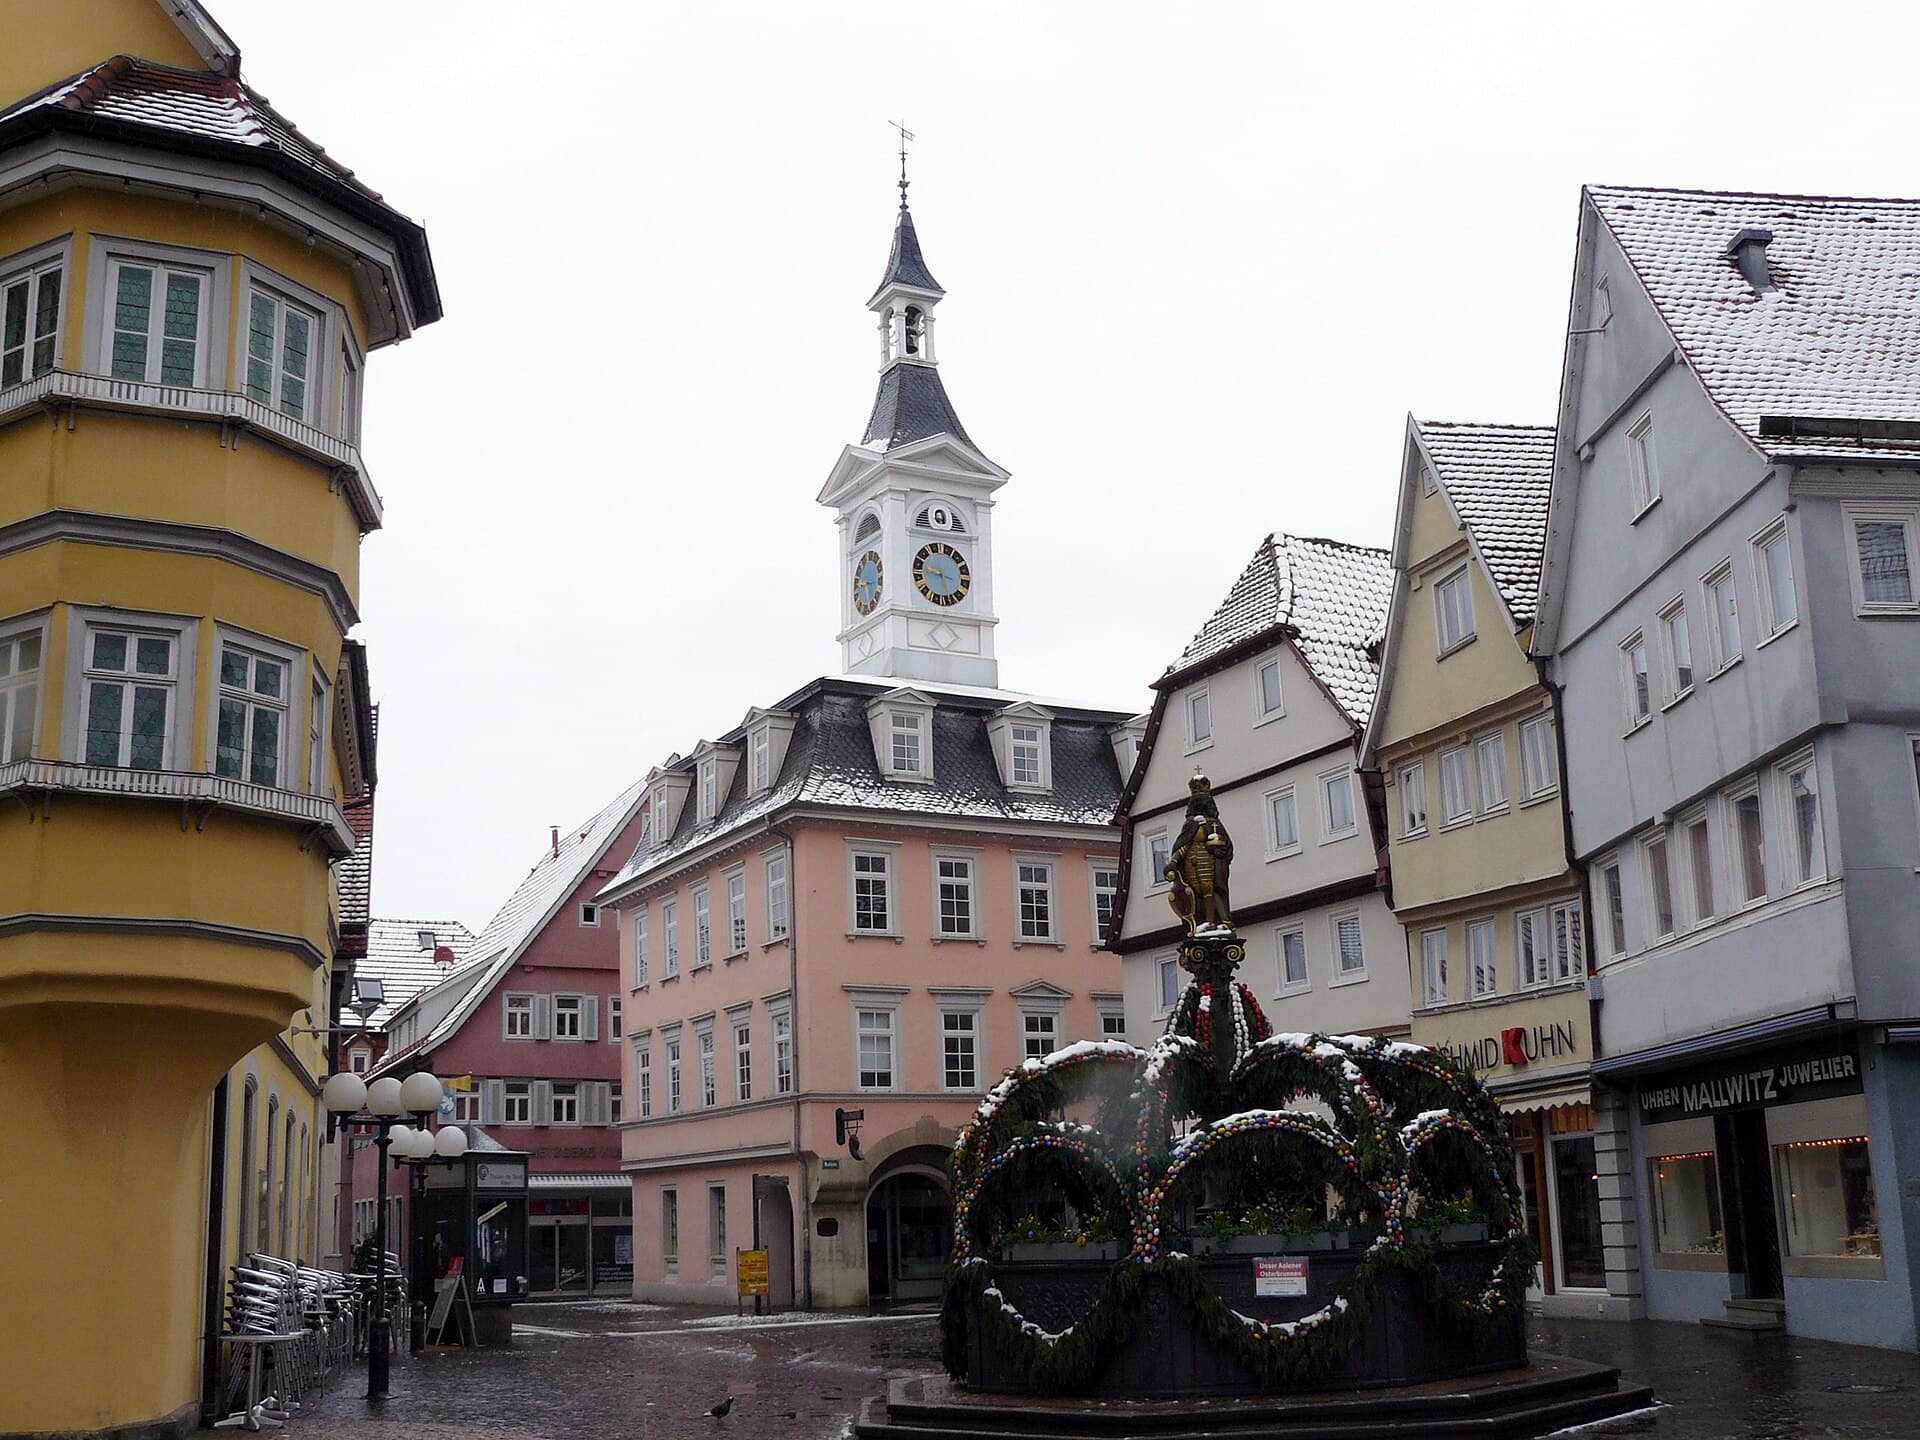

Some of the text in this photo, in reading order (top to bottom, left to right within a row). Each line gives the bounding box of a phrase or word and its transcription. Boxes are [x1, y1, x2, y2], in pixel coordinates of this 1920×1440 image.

[1426, 1020, 1574, 1073] HMID KUHN
[1641, 1055, 1856, 1113] UHREN MALLWITZ JUWELIER
